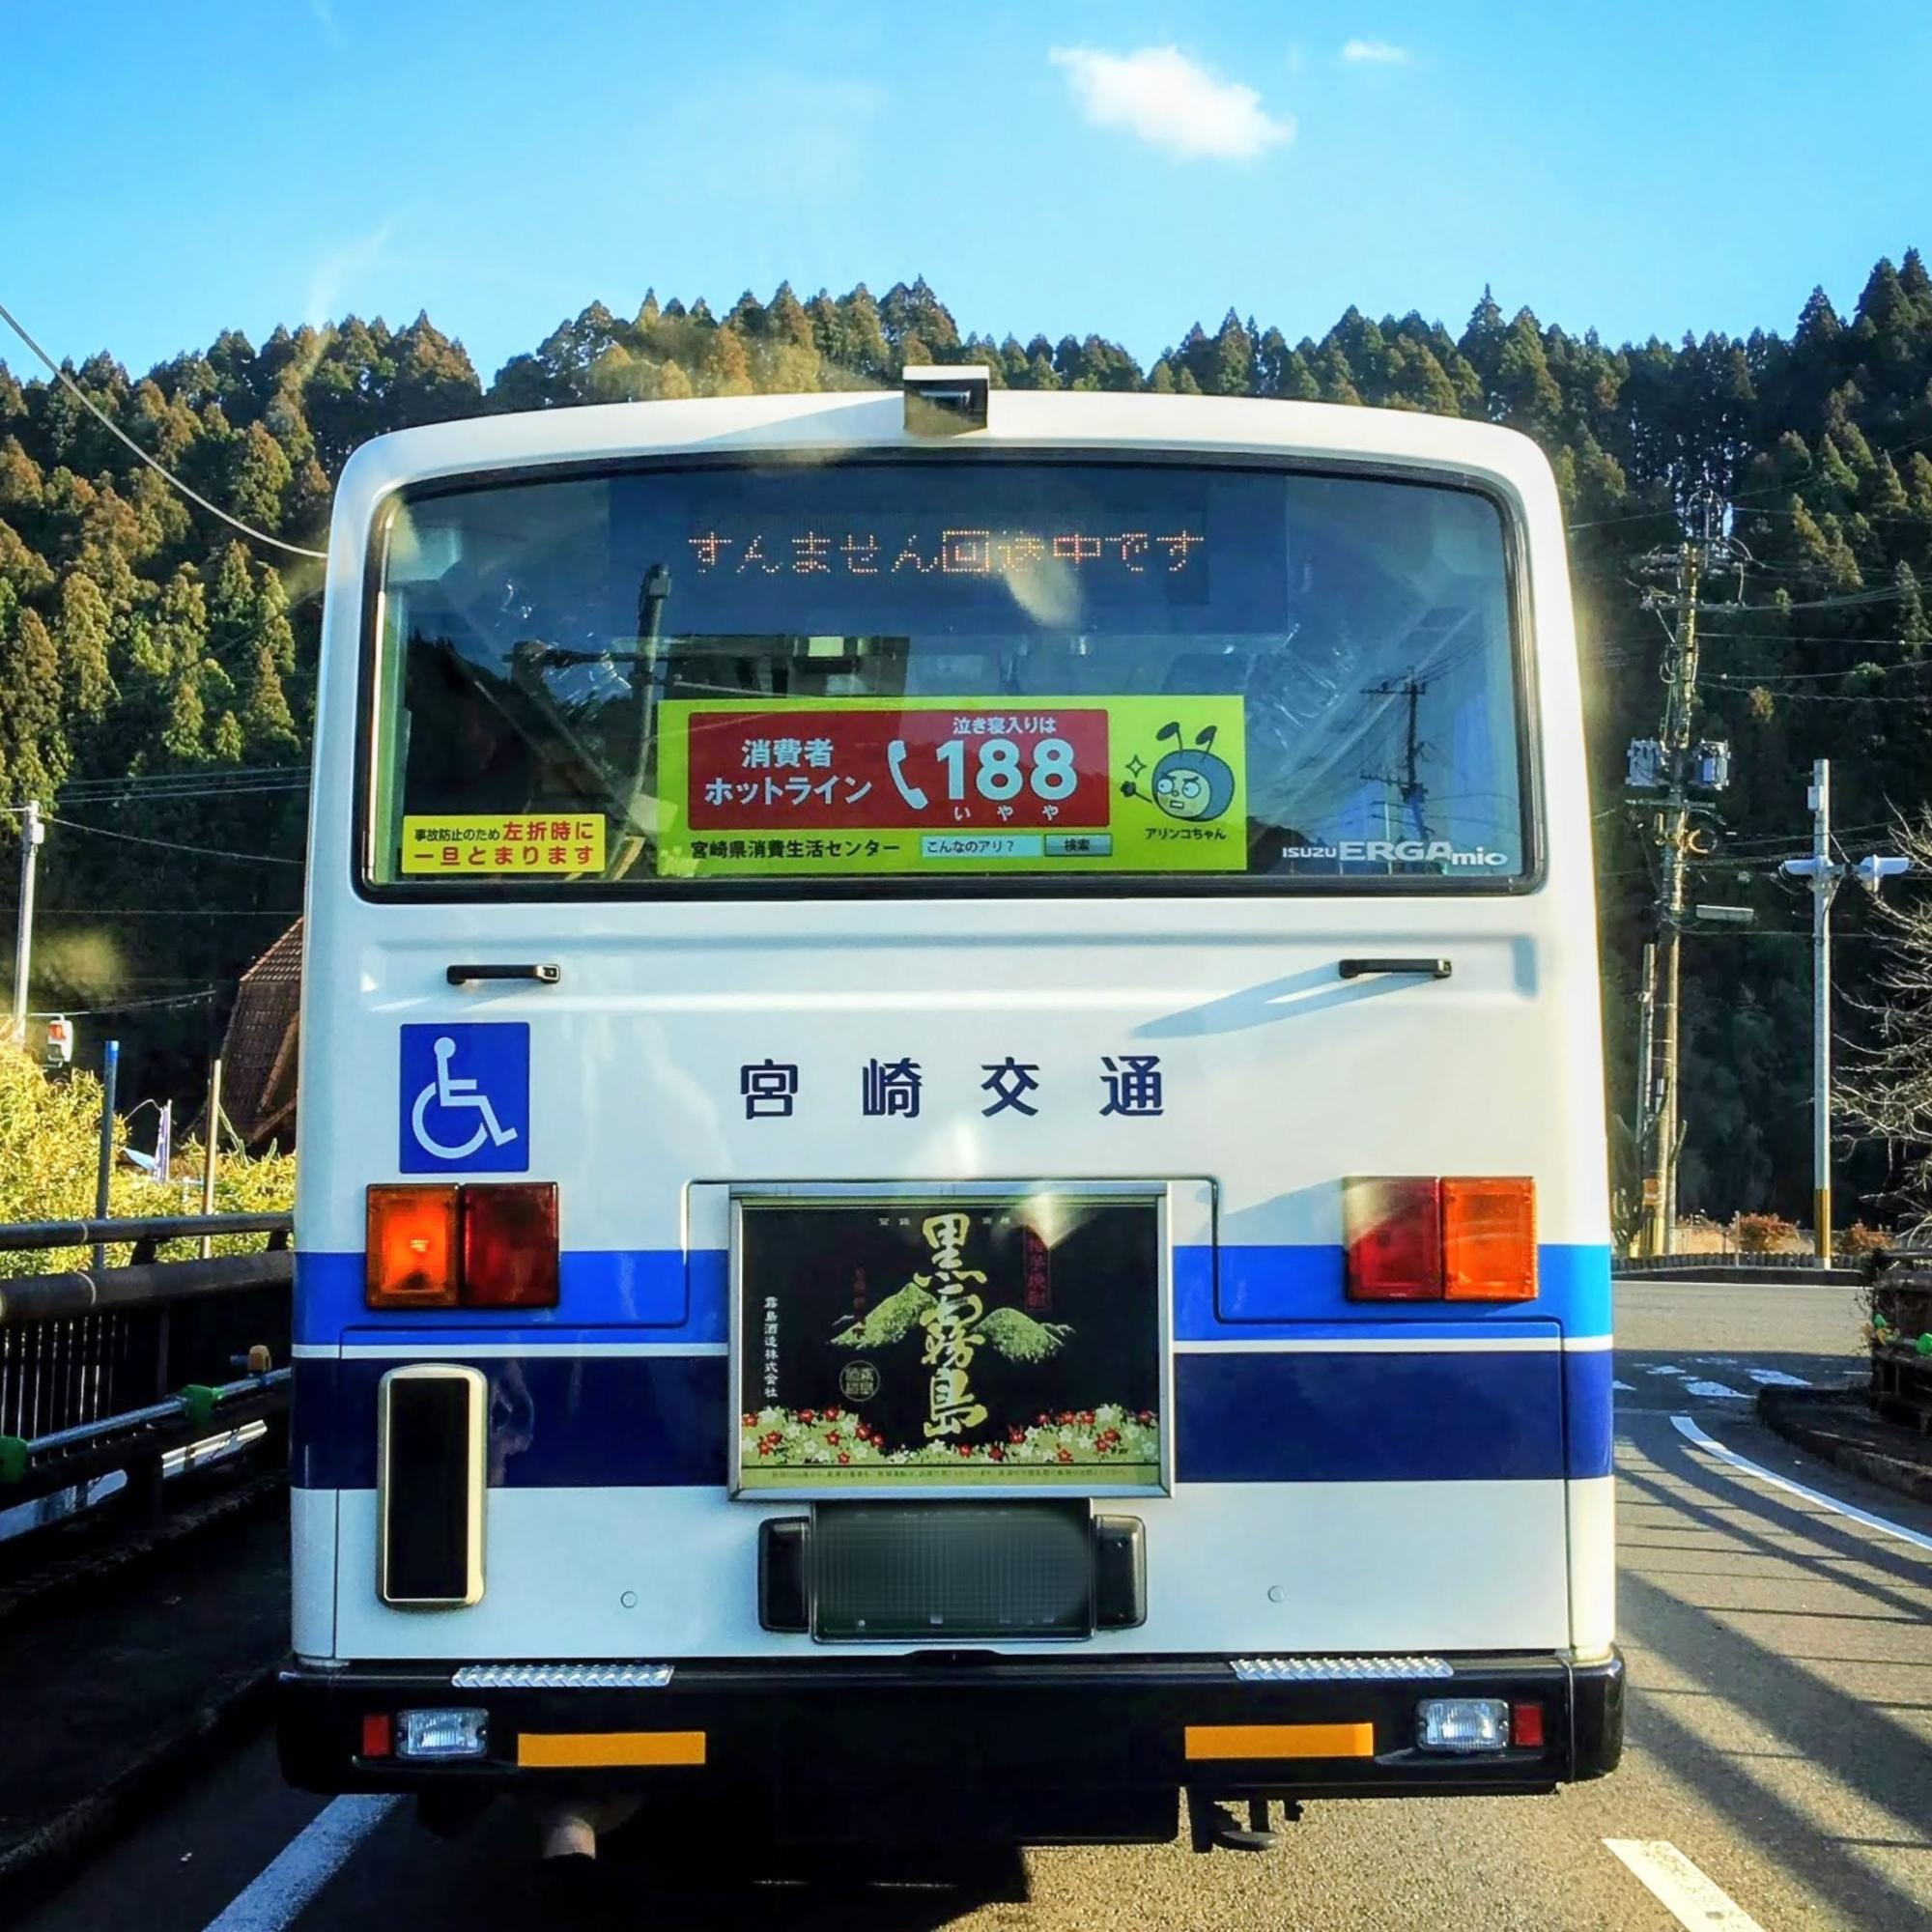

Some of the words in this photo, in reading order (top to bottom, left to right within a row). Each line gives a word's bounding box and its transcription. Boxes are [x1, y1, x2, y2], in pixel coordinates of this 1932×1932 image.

[688, 529, 1206, 573] すんません回送中です
[952, 717, 1057, 734] 泣き寝入りは
[741, 738, 834, 769] 消費者
[936, 737, 1078, 801] 188
[704, 774, 872, 806] ホットライン
[1064, 838, 1091, 852] 検索
[1145, 827, 1227, 841] アリンコちゃん
[414, 846, 594, 866] 一旦とまります
[690, 839, 900, 860] 宮崎県消費生活センター
[1282, 846, 1337, 859] ISUZU
[739, 1055, 1165, 1121] 宮崎交通
[912, 1212, 989, 1438] 黒霧島
